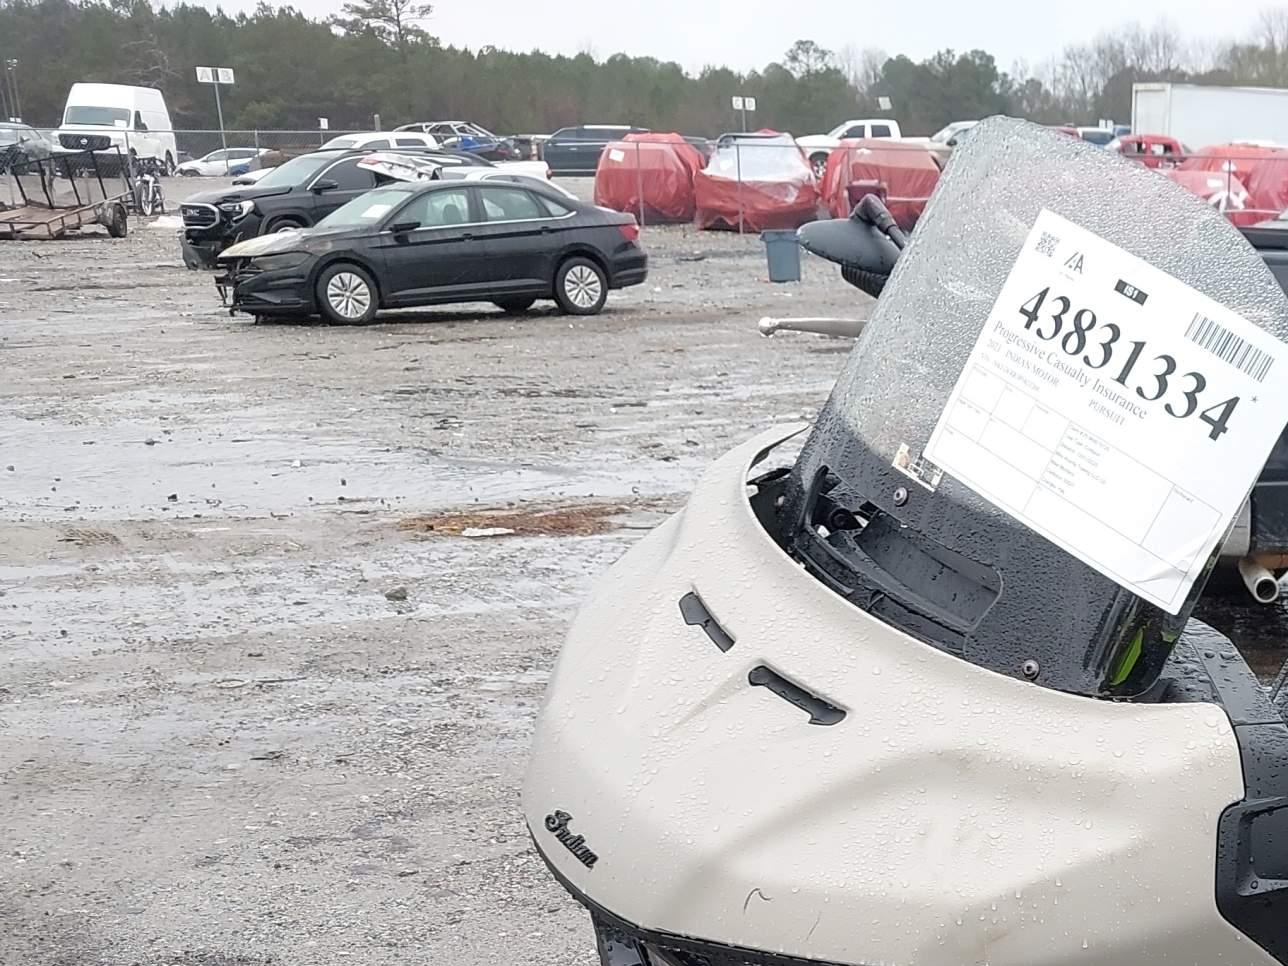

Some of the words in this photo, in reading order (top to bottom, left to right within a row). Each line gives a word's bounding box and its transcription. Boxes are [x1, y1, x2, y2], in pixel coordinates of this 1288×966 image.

[993, 320, 1046, 360] Progressive
[1046, 351, 1090, 388] Casualty
[1092, 378, 1148, 420] Insurance
[1018, 286, 1241, 442] 43831334
[544, 809, 600, 870] Indian
